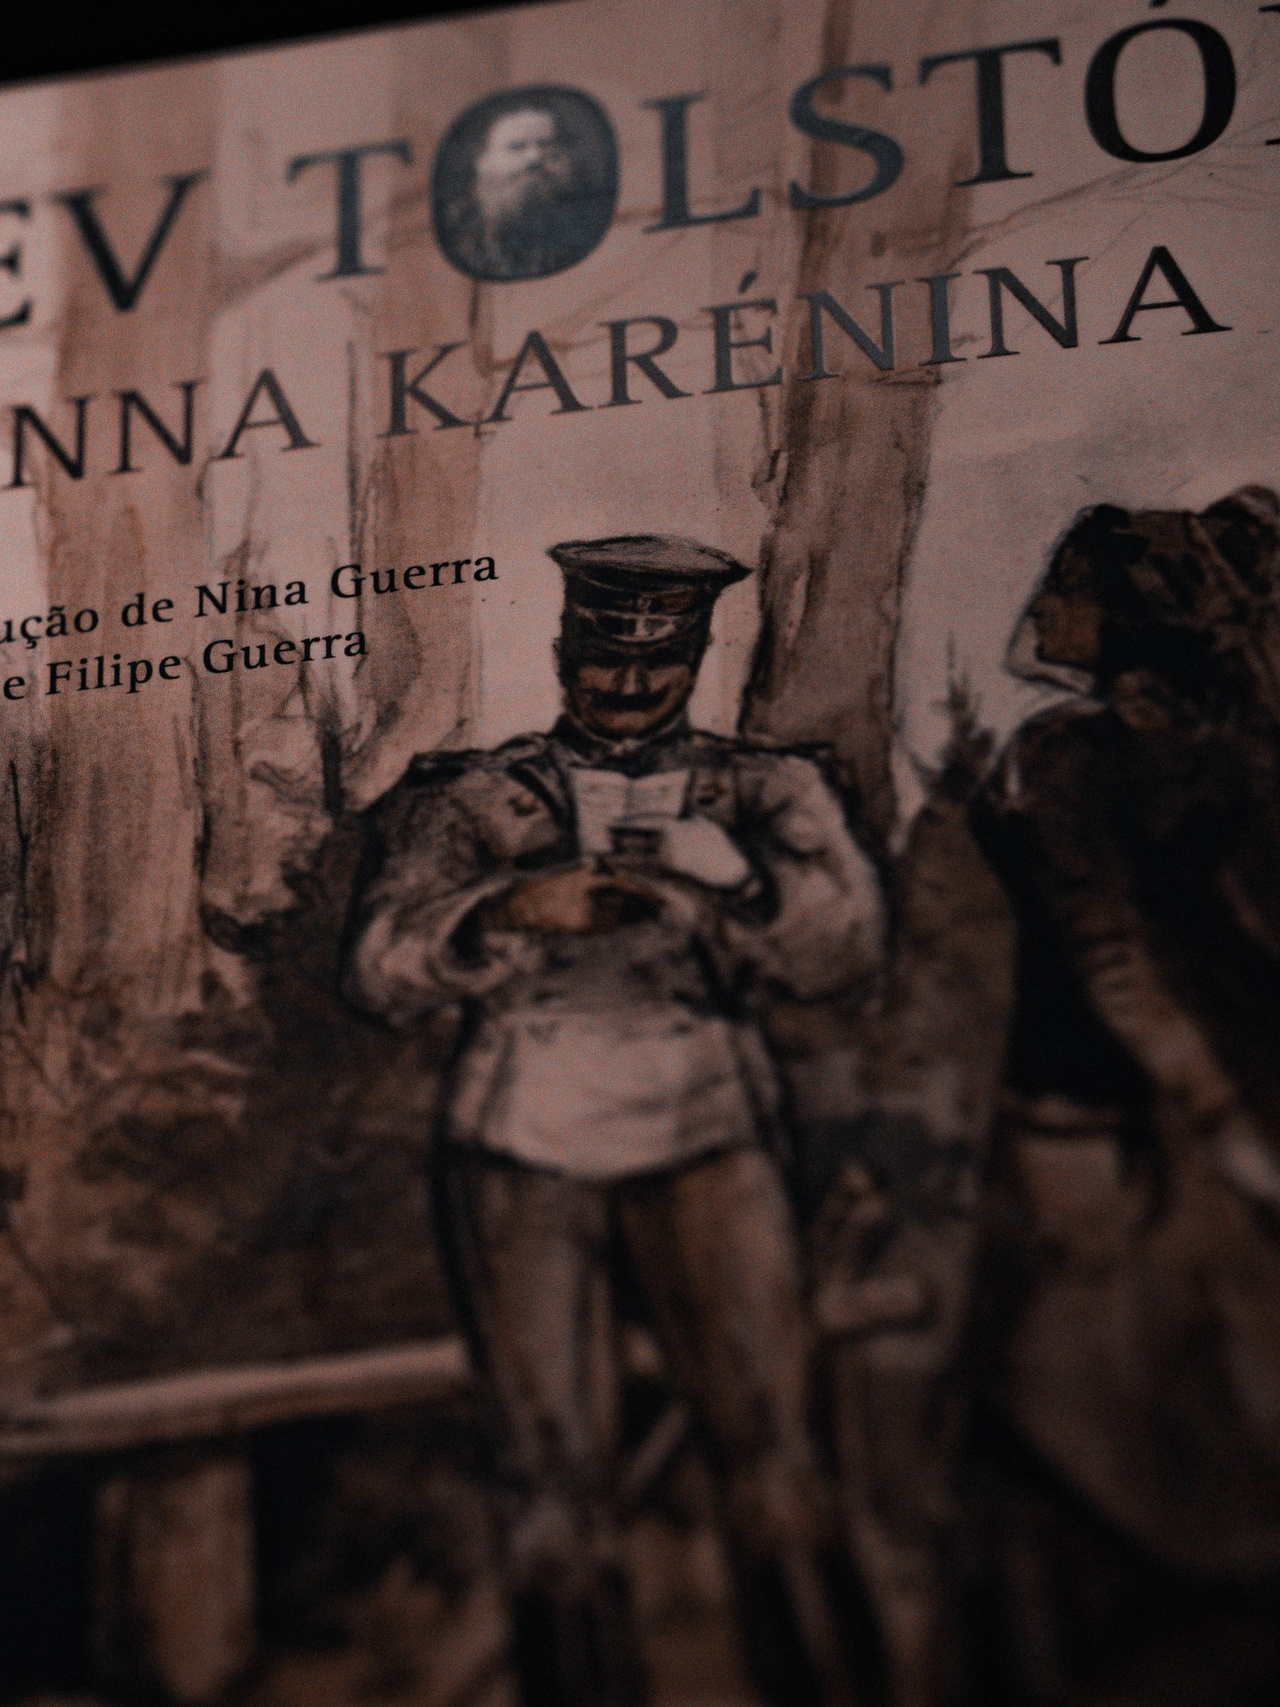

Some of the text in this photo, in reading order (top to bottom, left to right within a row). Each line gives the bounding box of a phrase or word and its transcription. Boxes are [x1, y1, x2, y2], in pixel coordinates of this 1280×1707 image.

[286, 0, 1280, 284] TOLSTÓ
[375, 246, 1232, 440] KARÉNINA
[120, 591, 175, 628] de
[194, 579, 309, 619] Nina
[330, 555, 499, 599] Guerra
[2, 629, 369, 701] e Filipe Guerra
